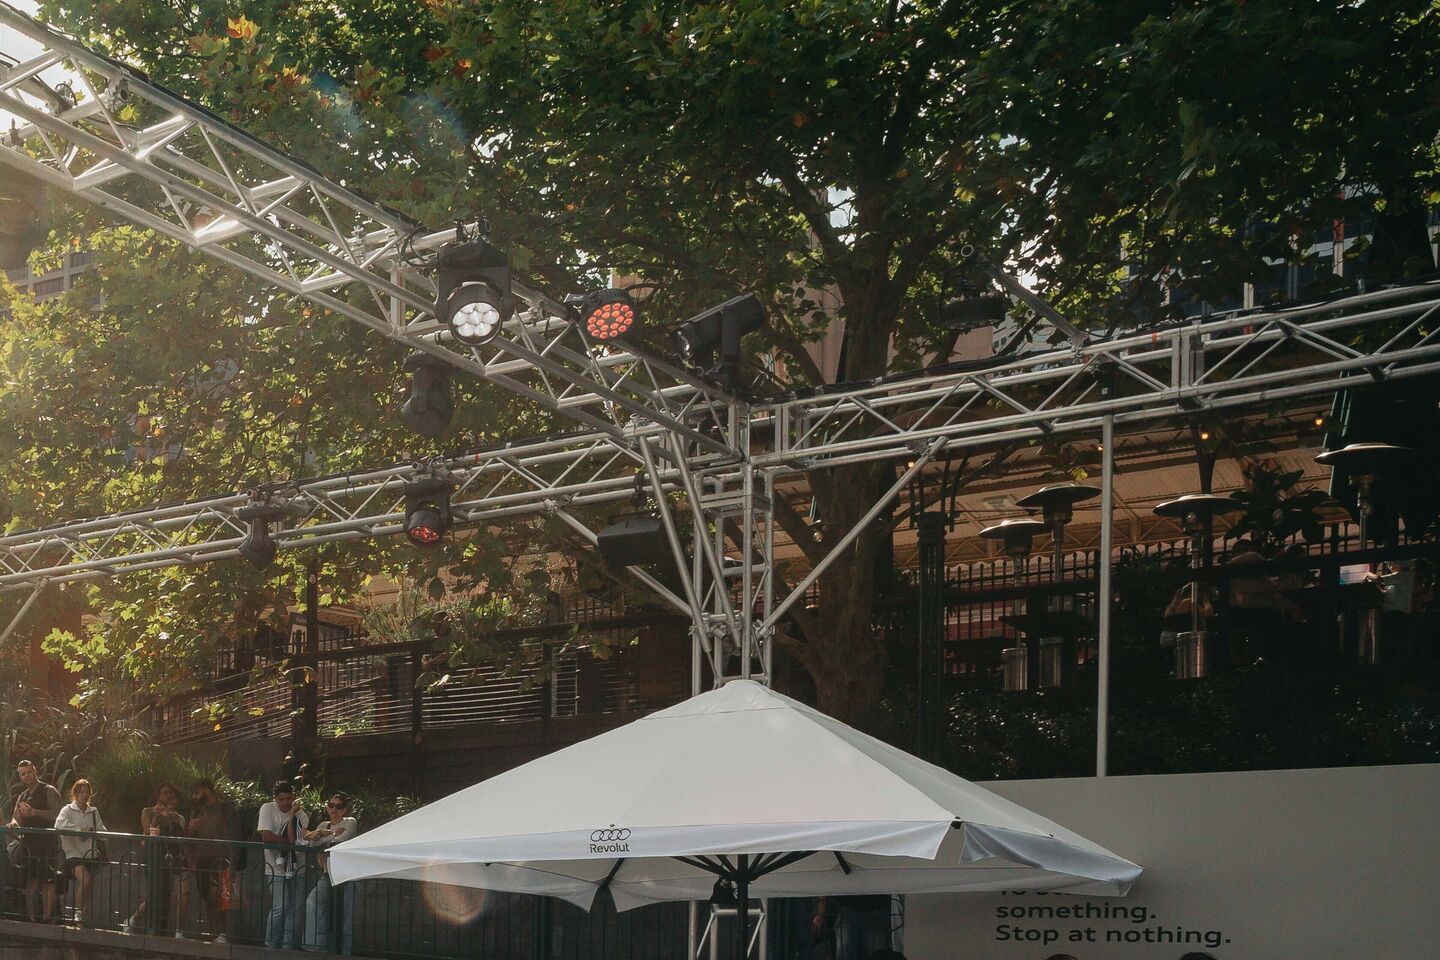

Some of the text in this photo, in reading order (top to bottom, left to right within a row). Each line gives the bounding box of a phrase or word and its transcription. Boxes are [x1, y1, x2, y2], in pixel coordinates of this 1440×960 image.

[589, 842, 630, 854] Revolut
[996, 903, 1157, 924] something.
[995, 925, 1232, 948] Stop at nothing.
